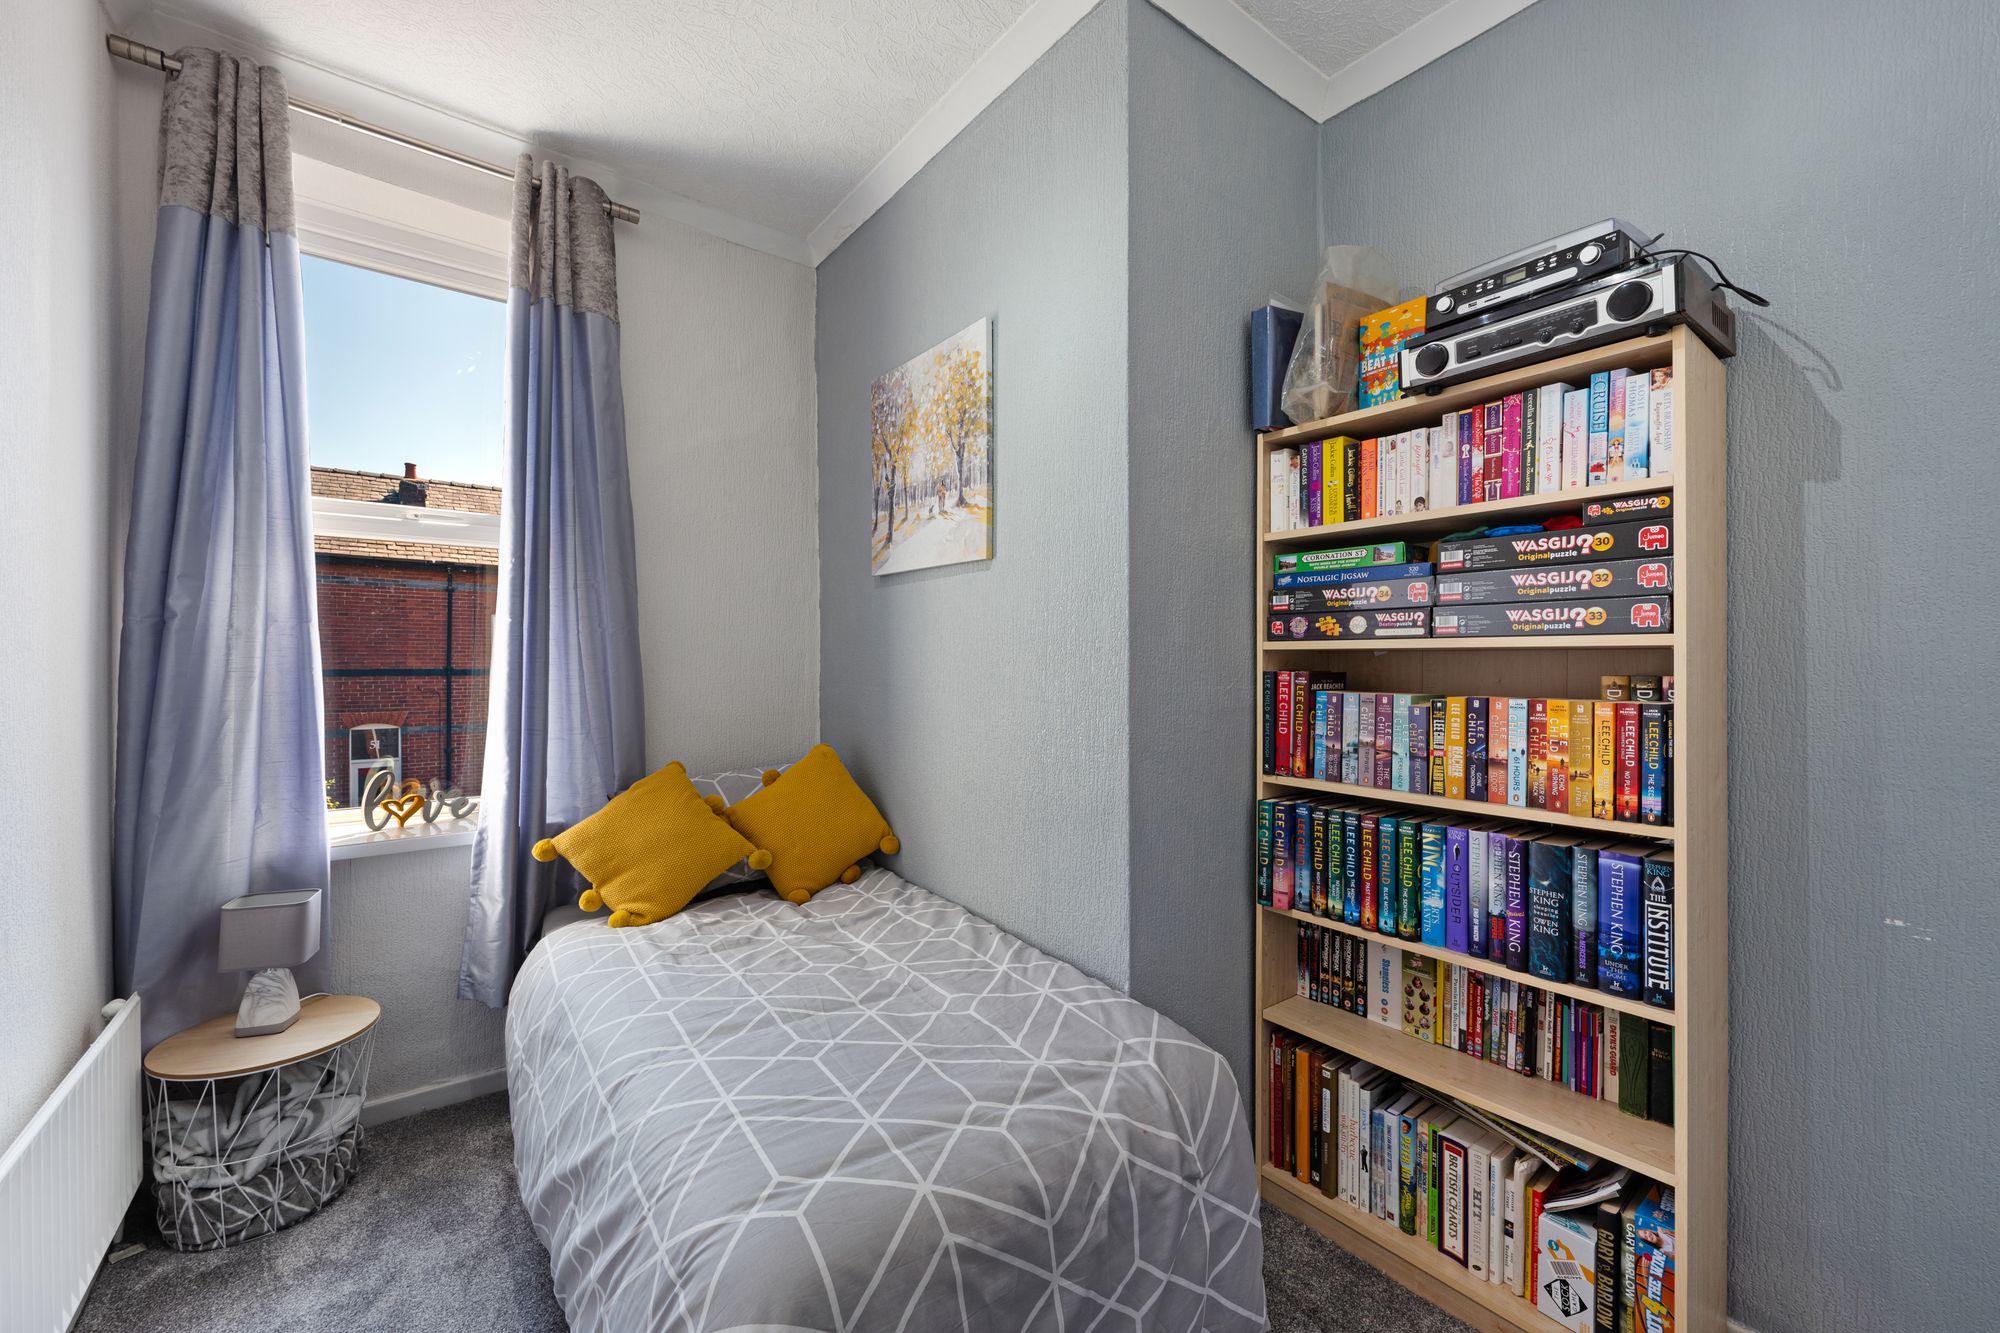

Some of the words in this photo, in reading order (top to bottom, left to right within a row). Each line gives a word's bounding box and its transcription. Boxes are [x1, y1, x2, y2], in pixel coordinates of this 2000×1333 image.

[1361, 355, 1386, 373] BEAT
[1527, 393, 1535, 417] cecelia
[1591, 381, 1607, 430] CRUISE
[1627, 379, 1638, 418] THOMAS
[1637, 384, 1647, 410] ROSIE
[1663, 392, 1672, 410] RITA
[1490, 406, 1498, 428] Cecelia
[1526, 419, 1535, 440] ahern
[1490, 434, 1498, 453] Ahern
[1655, 432, 1663, 445] Angel
[1663, 411, 1673, 452] BRADSHAW
[1311, 445, 1320, 462] Jackie
[1311, 462, 1320, 481] Collins
[1329, 460, 1337, 478] Collins
[1347, 468, 1356, 487] Collins
[1595, 537, 1610, 546] 30
[1305, 551, 1353, 562] CORONATION
[1355, 549, 1365, 557] ST
[1297, 574, 1339, 584] NOSTALGIC
[1341, 571, 1369, 581] JIGSAW
[1595, 574, 1610, 583] 32
[1589, 611, 1604, 621] 33
[1280, 682, 1288, 700] LEE
[1279, 703, 1288, 734] CHILD
[1296, 704, 1304, 732] CHILD
[1468, 713, 1477, 745] CHILD
[1477, 721, 1485, 739] LEE
[1602, 720, 1611, 737] LEE
[1626, 720, 1635, 737] LEE
[1649, 721, 1659, 738] LEE
[1549, 718, 1559, 753] CHILD
[1559, 725, 1568, 747] LEE
[1513, 756, 1521, 764] 61
[1602, 738, 1611, 766] CHILD
[1626, 739, 1635, 767] CHILD
[1648, 740, 1659, 770] CHILD
[1414, 772, 1422, 792] ENEMY
[1433, 765, 1444, 780] HARD
[1513, 766, 1521, 792] HOURS
[1551, 767, 1559, 796] BURNING
[1624, 770, 1630, 778] NO
[1647, 773, 1655, 785] THE
[1432, 781, 1444, 794] WAY
[1574, 786, 1582, 808] AFFAIR
[1275, 805, 1284, 827] LEE
[1315, 820, 1323, 839] LEE
[1331, 823, 1341, 842] LEE
[1346, 826, 1355, 845] LEE
[1363, 829, 1371, 848] LEE
[1381, 832, 1391, 851] LEE
[1260, 829, 1269, 865] CHILD
[1275, 830, 1285, 867] CHILD
[1315, 840, 1323, 870] CHILD
[1403, 836, 1413, 854] LEE
[1422, 832, 1442, 872] KING
[1472, 836, 1481, 879] STEPHEN
[1331, 843, 1341, 874] CHILD
[1346, 846, 1355, 878] CHILD
[1363, 849, 1371, 880] CHILD
[1381, 853, 1391, 885] CHILD
[1403, 856, 1413, 887] CHILD
[1493, 839, 1502, 882] STEPHEN
[1509, 850, 1521, 909] STEPHEN
[1577, 853, 1588, 899] STEPHEN
[1451, 863, 1462, 924] OUTSIDER
[1471, 879, 1480, 904] KING
[1493, 882, 1502, 907] KING
[1529, 887, 1565, 899] STEPHEN
[1533, 895, 1559, 907] KING
[1611, 862, 1624, 919] STEPHEN
[1649, 893, 1666, 903] THE
[1533, 917, 1558, 927] OWEN
[1577, 900, 1588, 927] KING
[1508, 918, 1521, 953] KING
[1533, 923, 1559, 937] KING
[1610, 922, 1624, 955] KING
[1579, 940, 1587, 970] MERCEDES
[1645, 900, 1672, 993] INSTITUTE
[1382, 958, 1390, 993] Shameless
[1605, 959, 1629, 970] UNDER
[1609, 1024, 1617, 1050] DEVIL'S
[1609, 1050, 1617, 1076] GUARD
[1349, 1119, 1359, 1161] barbecue
[1401, 1134, 1412, 1164] PETER
[1401, 1165, 1412, 1185] KAY
[1447, 1153, 1458, 1197] BRITISH
[1473, 1153, 1482, 1188] BRITISH
[1472, 1187, 1483, 1222] HIT
[1447, 1198, 1458, 1240] CHARTS
[1472, 1221, 1482, 1256] SINGLES
[1598, 1229, 1615, 1266] GARY
[1625, 1223, 1636, 1253] GARY
[1648, 1249, 1666, 1277] WIN!
[1625, 1252, 1636, 1302] BARLOW
[1647, 1277, 1662, 1301] THE
[1560, 1278, 1570, 1312] SOCK
[1572, 1290, 1580, 1312] GAME
[1597, 1273, 1615, 1330] BARLOW
